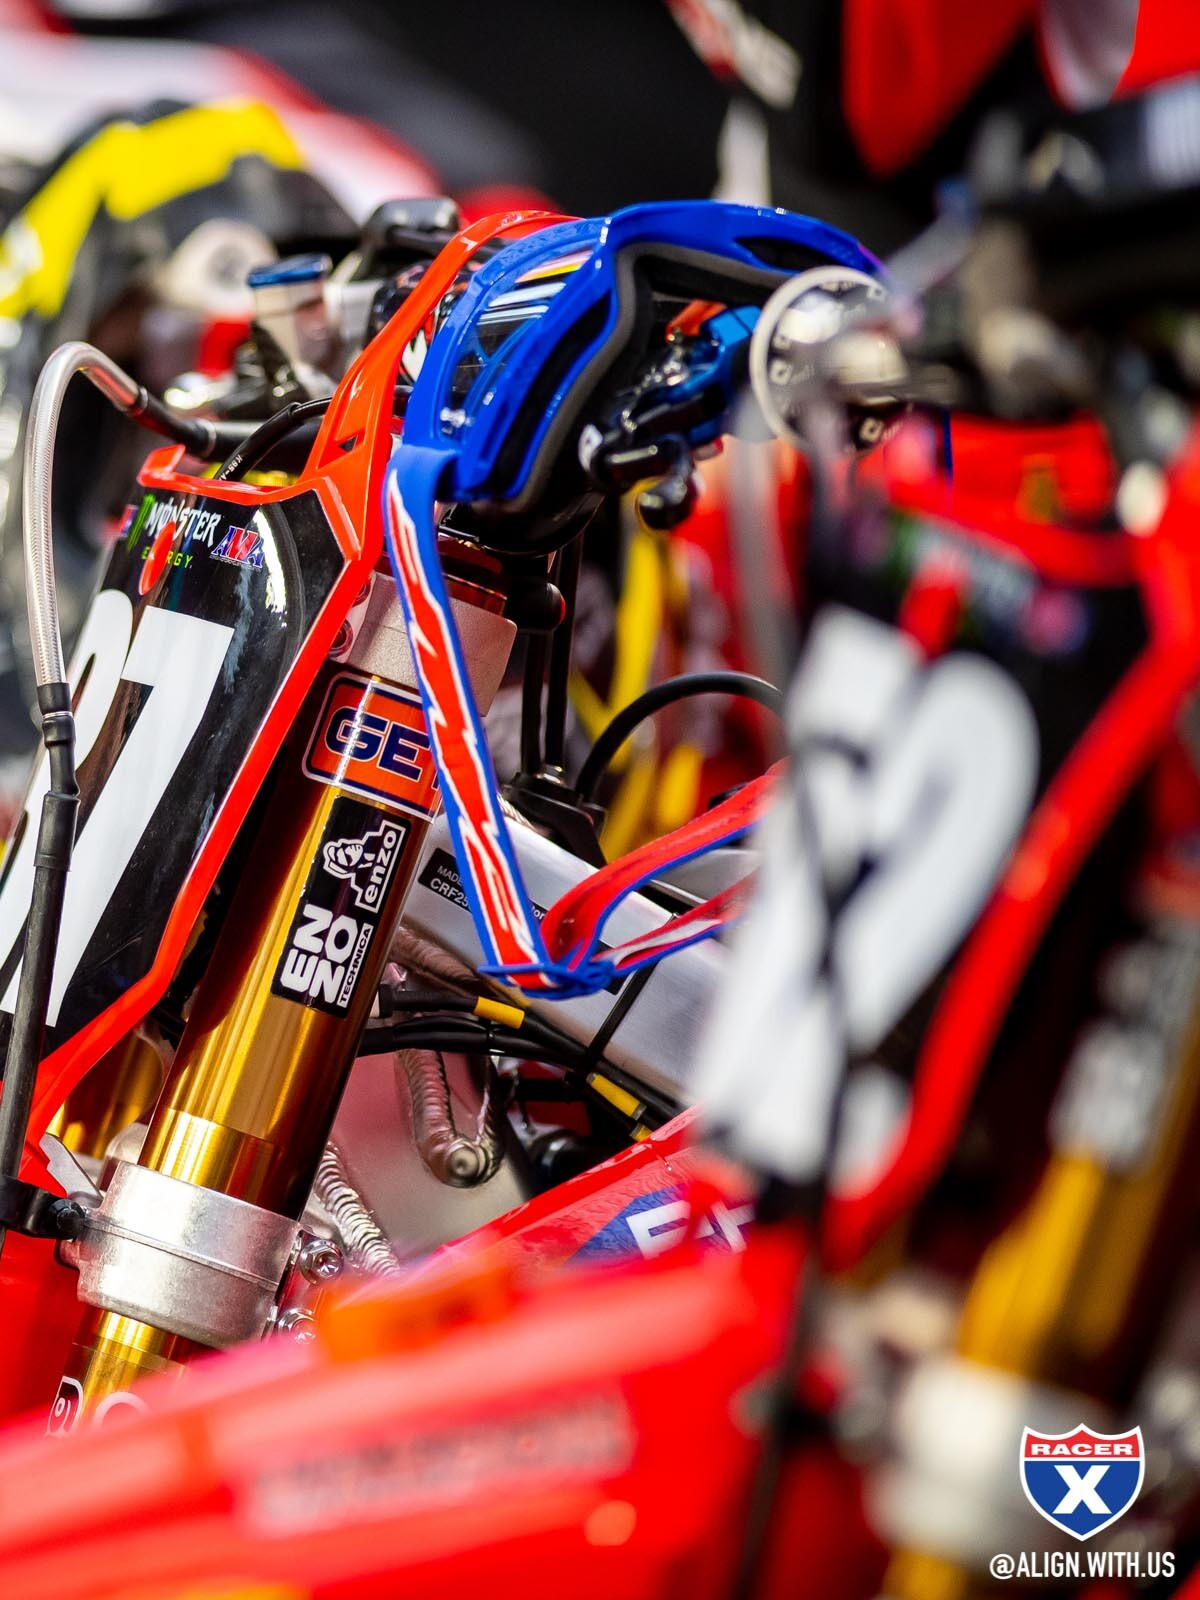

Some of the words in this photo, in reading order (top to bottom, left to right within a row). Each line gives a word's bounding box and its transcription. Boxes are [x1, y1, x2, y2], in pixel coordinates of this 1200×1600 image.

[144, 497, 222, 548] MONSTER
[211, 526, 264, 569] AMA
[325, 706, 441, 791] GE
[363, 829, 398, 905] enzo
[430, 877, 472, 913] CRF25
[338, 926, 372, 1006] TECHNICA
